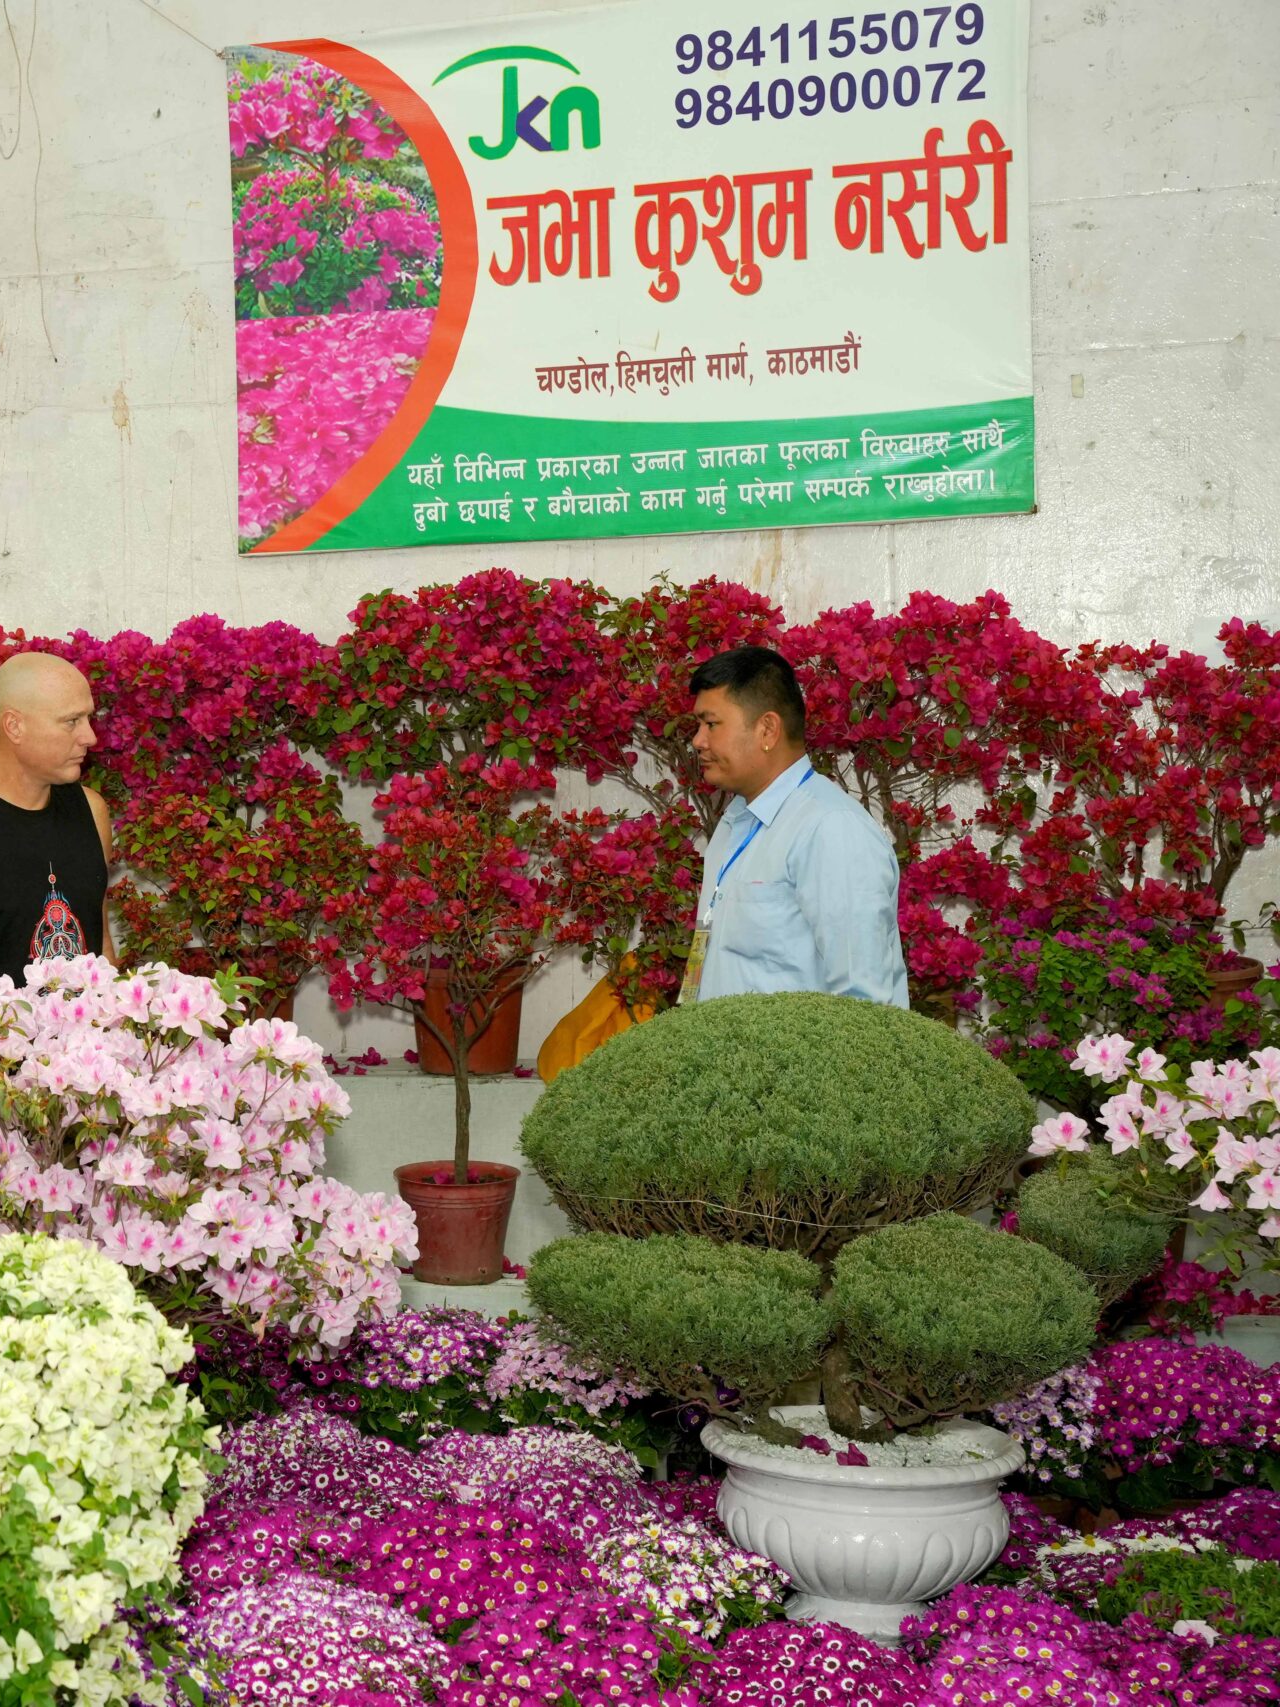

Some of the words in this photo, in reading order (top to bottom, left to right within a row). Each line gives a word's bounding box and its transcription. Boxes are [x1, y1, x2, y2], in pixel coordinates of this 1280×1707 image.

[674, 2, 985, 75] 9841155079
[674, 58, 987, 129] 9840900072
[487, 187, 615, 286] जभा
[634, 168, 813, 303] कुशुम
[832, 119, 1014, 260] नर्सरी
[407, 453, 444, 489] यहाँ
[454, 452, 527, 483] विभिन्न
[536, 454, 621, 481] प्रकारका
[630, 450, 687, 474] उन्नत
[696, 443, 769, 469] जातका
[778, 438, 850, 470] फूलका
[960, 418, 1006, 454] साथै
[457, 491, 513, 524] छपाई
[522, 497, 539, 522] र
[547, 486, 631, 516] बगैचाको
[640, 488, 687, 510] काम
[695, 478, 728, 515] गर्नु
[737, 477, 794, 508] परेमा
[804, 469, 873, 503] सम्पर्क
